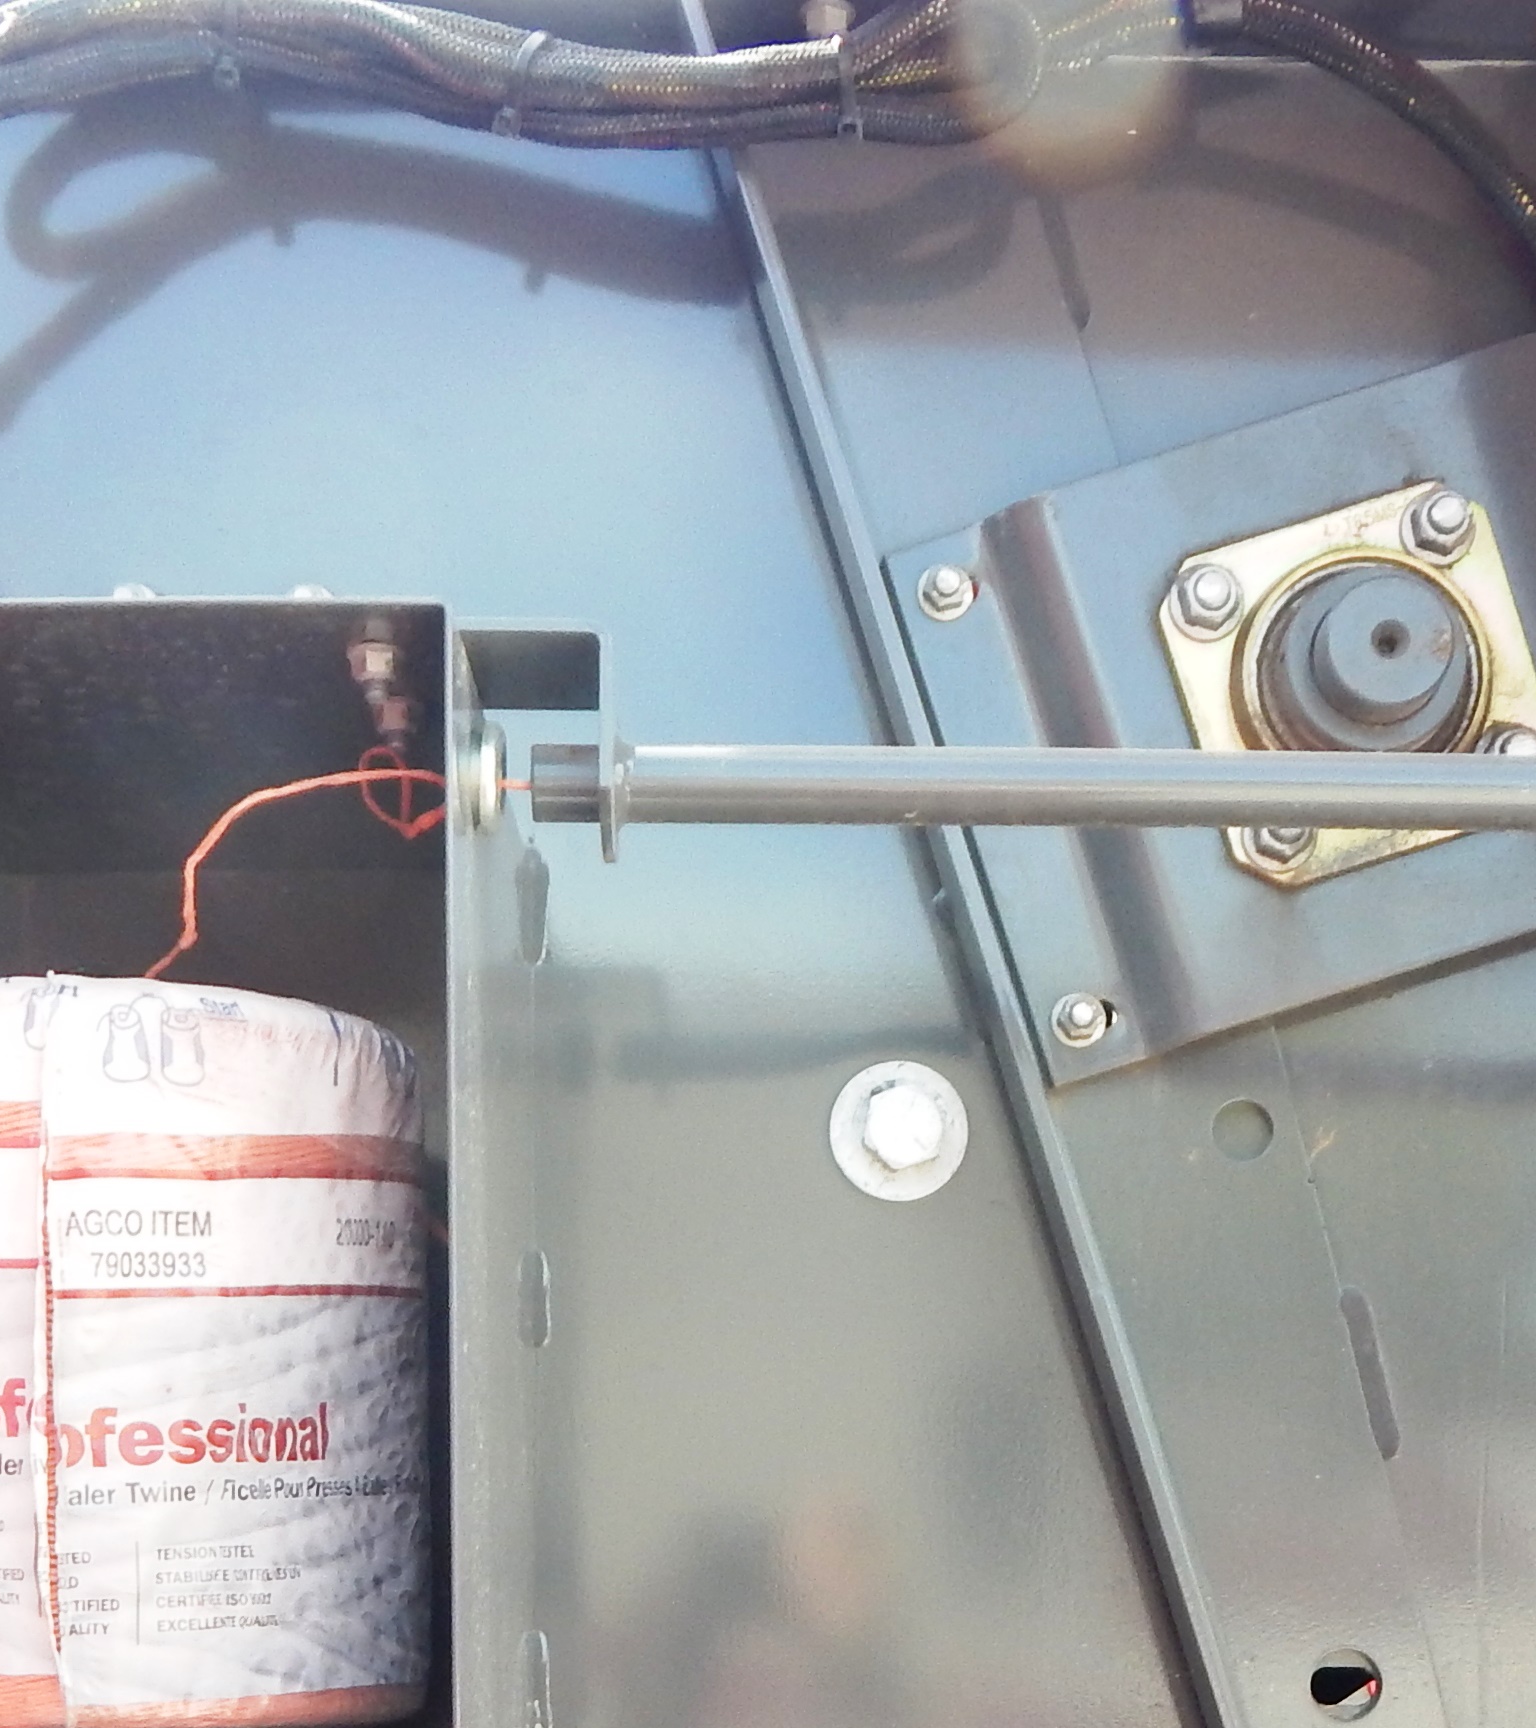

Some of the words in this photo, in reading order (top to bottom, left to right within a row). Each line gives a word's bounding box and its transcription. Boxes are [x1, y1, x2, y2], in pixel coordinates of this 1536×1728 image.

[65, 1210, 143, 1238] AGCO
[152, 1210, 213, 1238] ITEM
[90, 1252, 207, 1278] 79033933
[125, 1479, 196, 1504] Twine
[157, 1546, 216, 1561] TENSION
